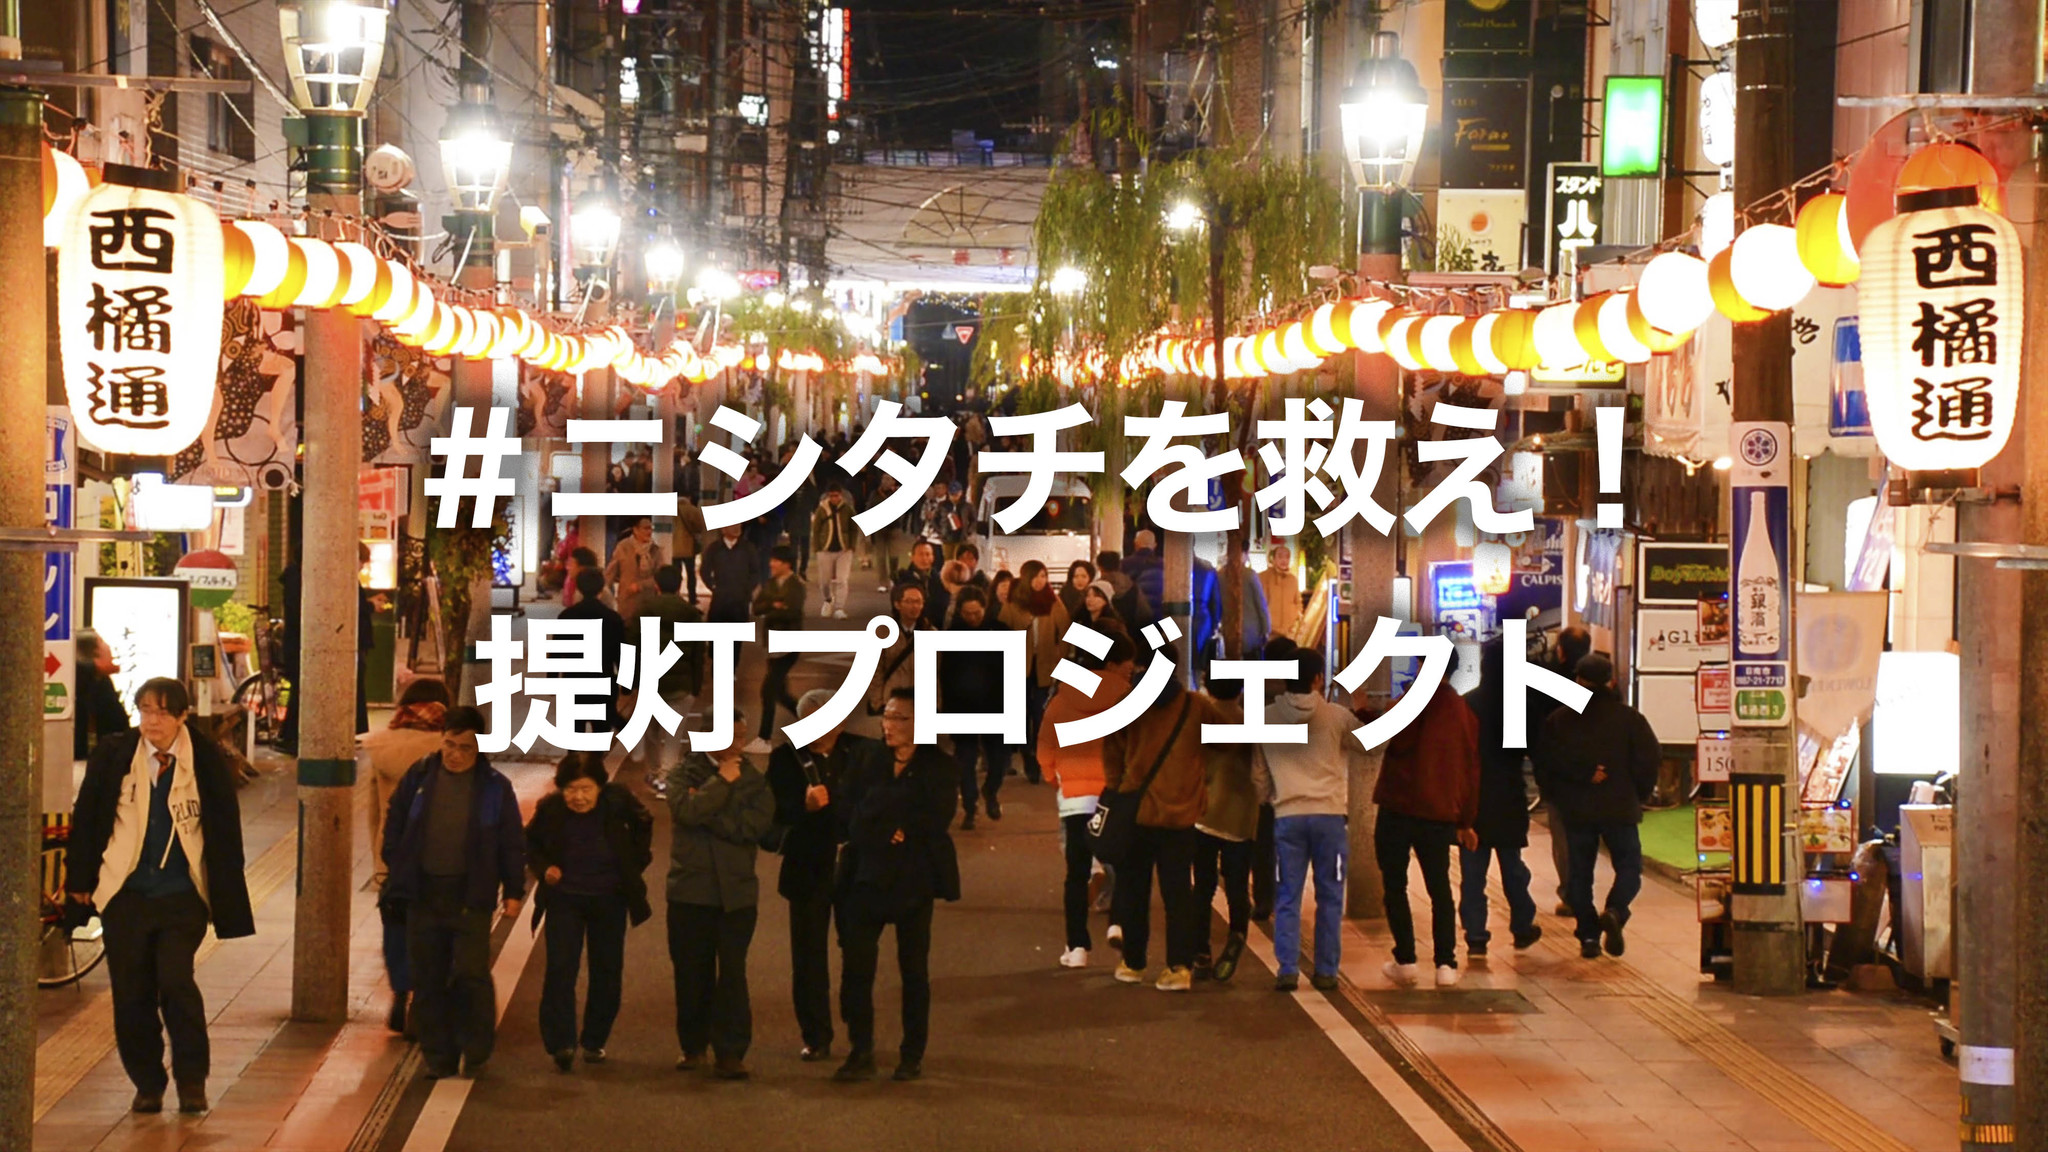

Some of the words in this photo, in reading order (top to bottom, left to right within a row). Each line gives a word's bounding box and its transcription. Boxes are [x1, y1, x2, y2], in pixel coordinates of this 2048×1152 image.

[1555, 175, 1602, 194] スタンド
[87, 208, 175, 430] 西橘通
[1911, 223, 1999, 441] 西橘通
[1772, 704, 1780, 717] 3
